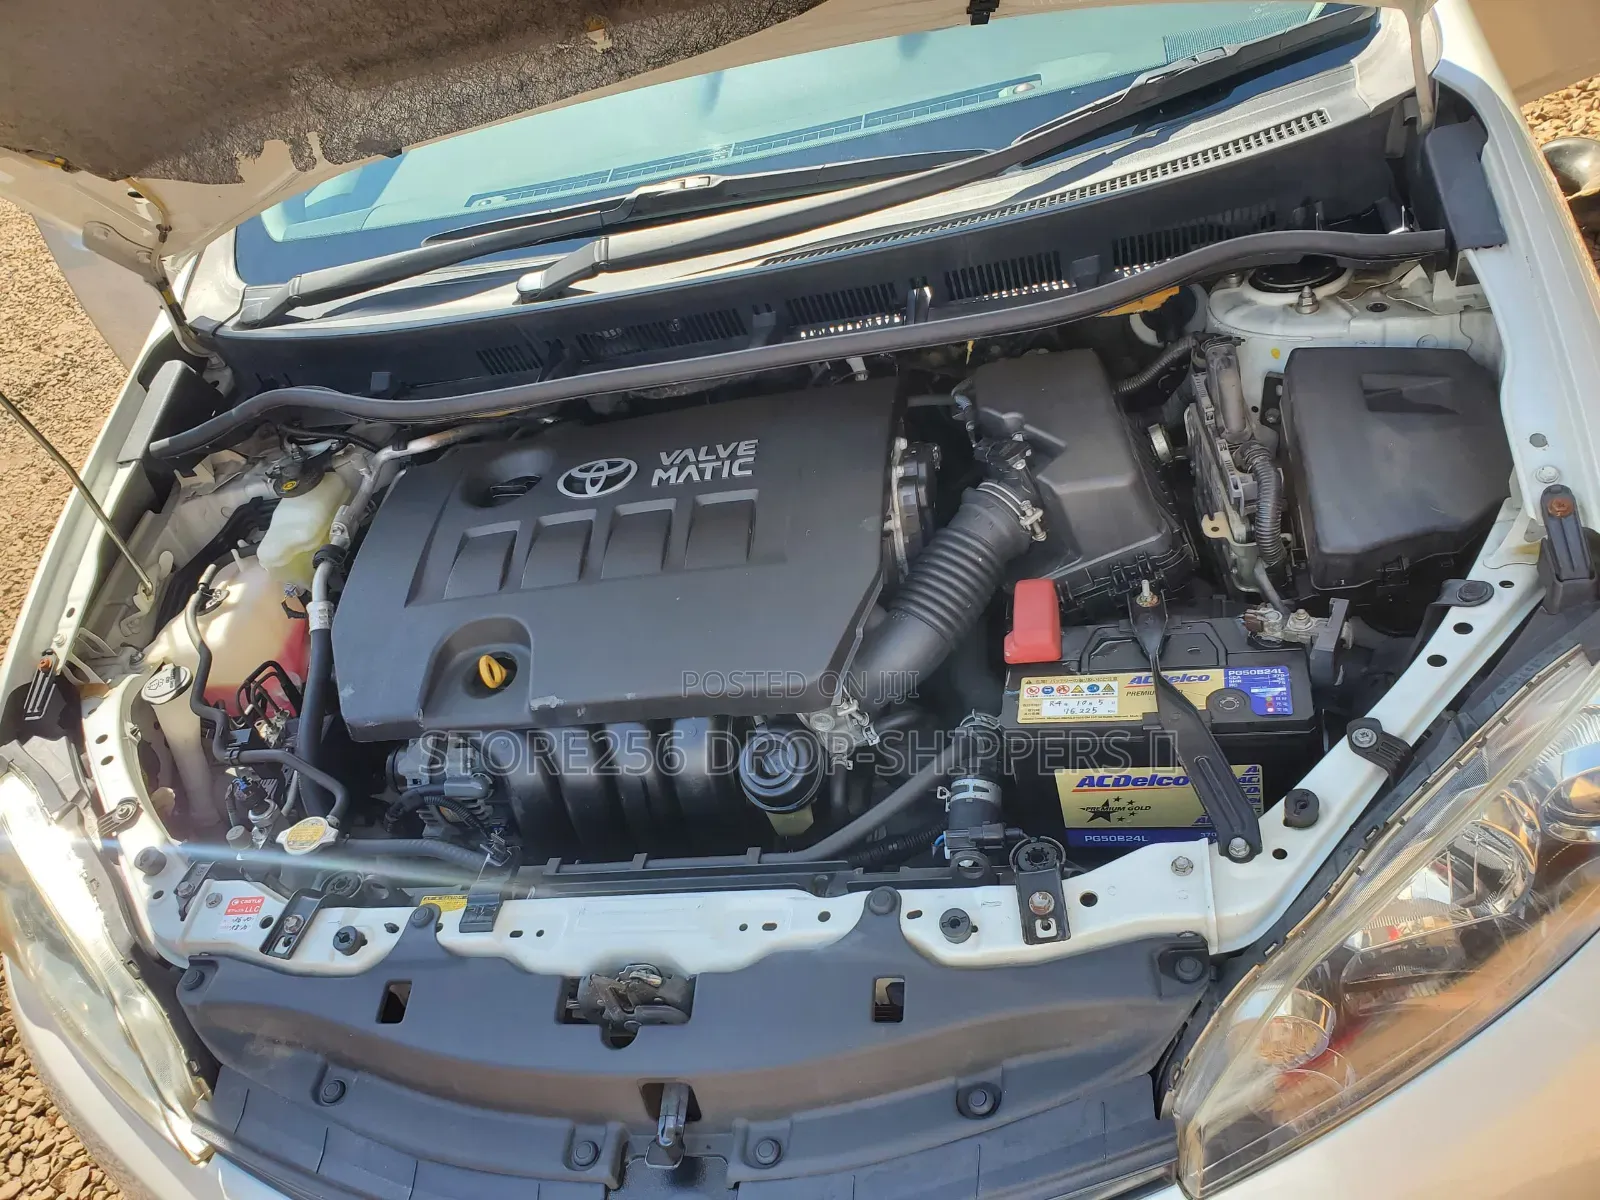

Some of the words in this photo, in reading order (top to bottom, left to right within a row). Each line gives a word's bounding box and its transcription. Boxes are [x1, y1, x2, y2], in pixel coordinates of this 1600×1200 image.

[659, 439, 758, 466] VALVE
[651, 457, 754, 487] MATIC
[1128, 673, 1211, 685] ACelco
[1228, 668, 1285, 676] PG50B24L
[1075, 774, 1191, 788] ACDelco
